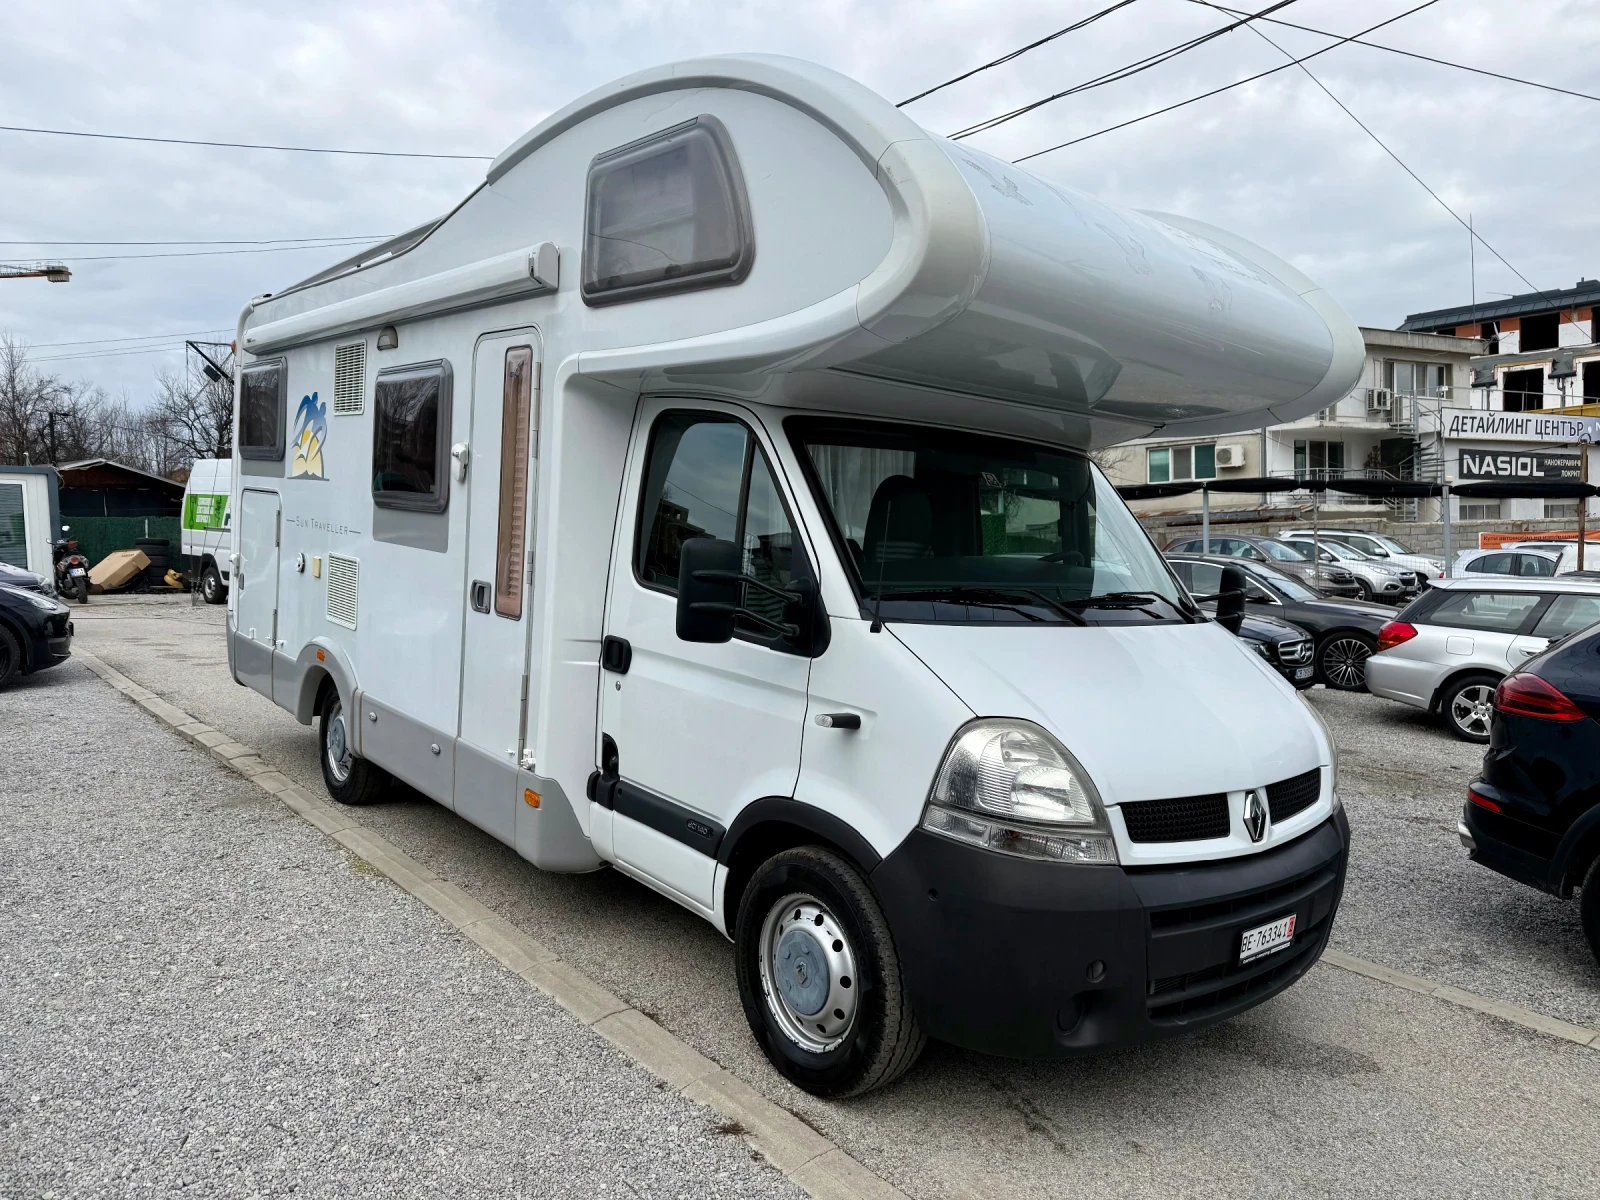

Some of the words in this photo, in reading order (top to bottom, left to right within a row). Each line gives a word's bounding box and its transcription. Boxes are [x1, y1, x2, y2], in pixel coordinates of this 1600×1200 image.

[1449, 413, 1532, 437] ДЕТАЙЛИНГ
[1535, 419, 1584, 439] ЦЕНТЪР
[1463, 454, 1545, 477] NASIOL
[1544, 458, 1581, 467] НАНОКЕРАМИЧ
[1561, 470, 1581, 478] ПОКРИТ
